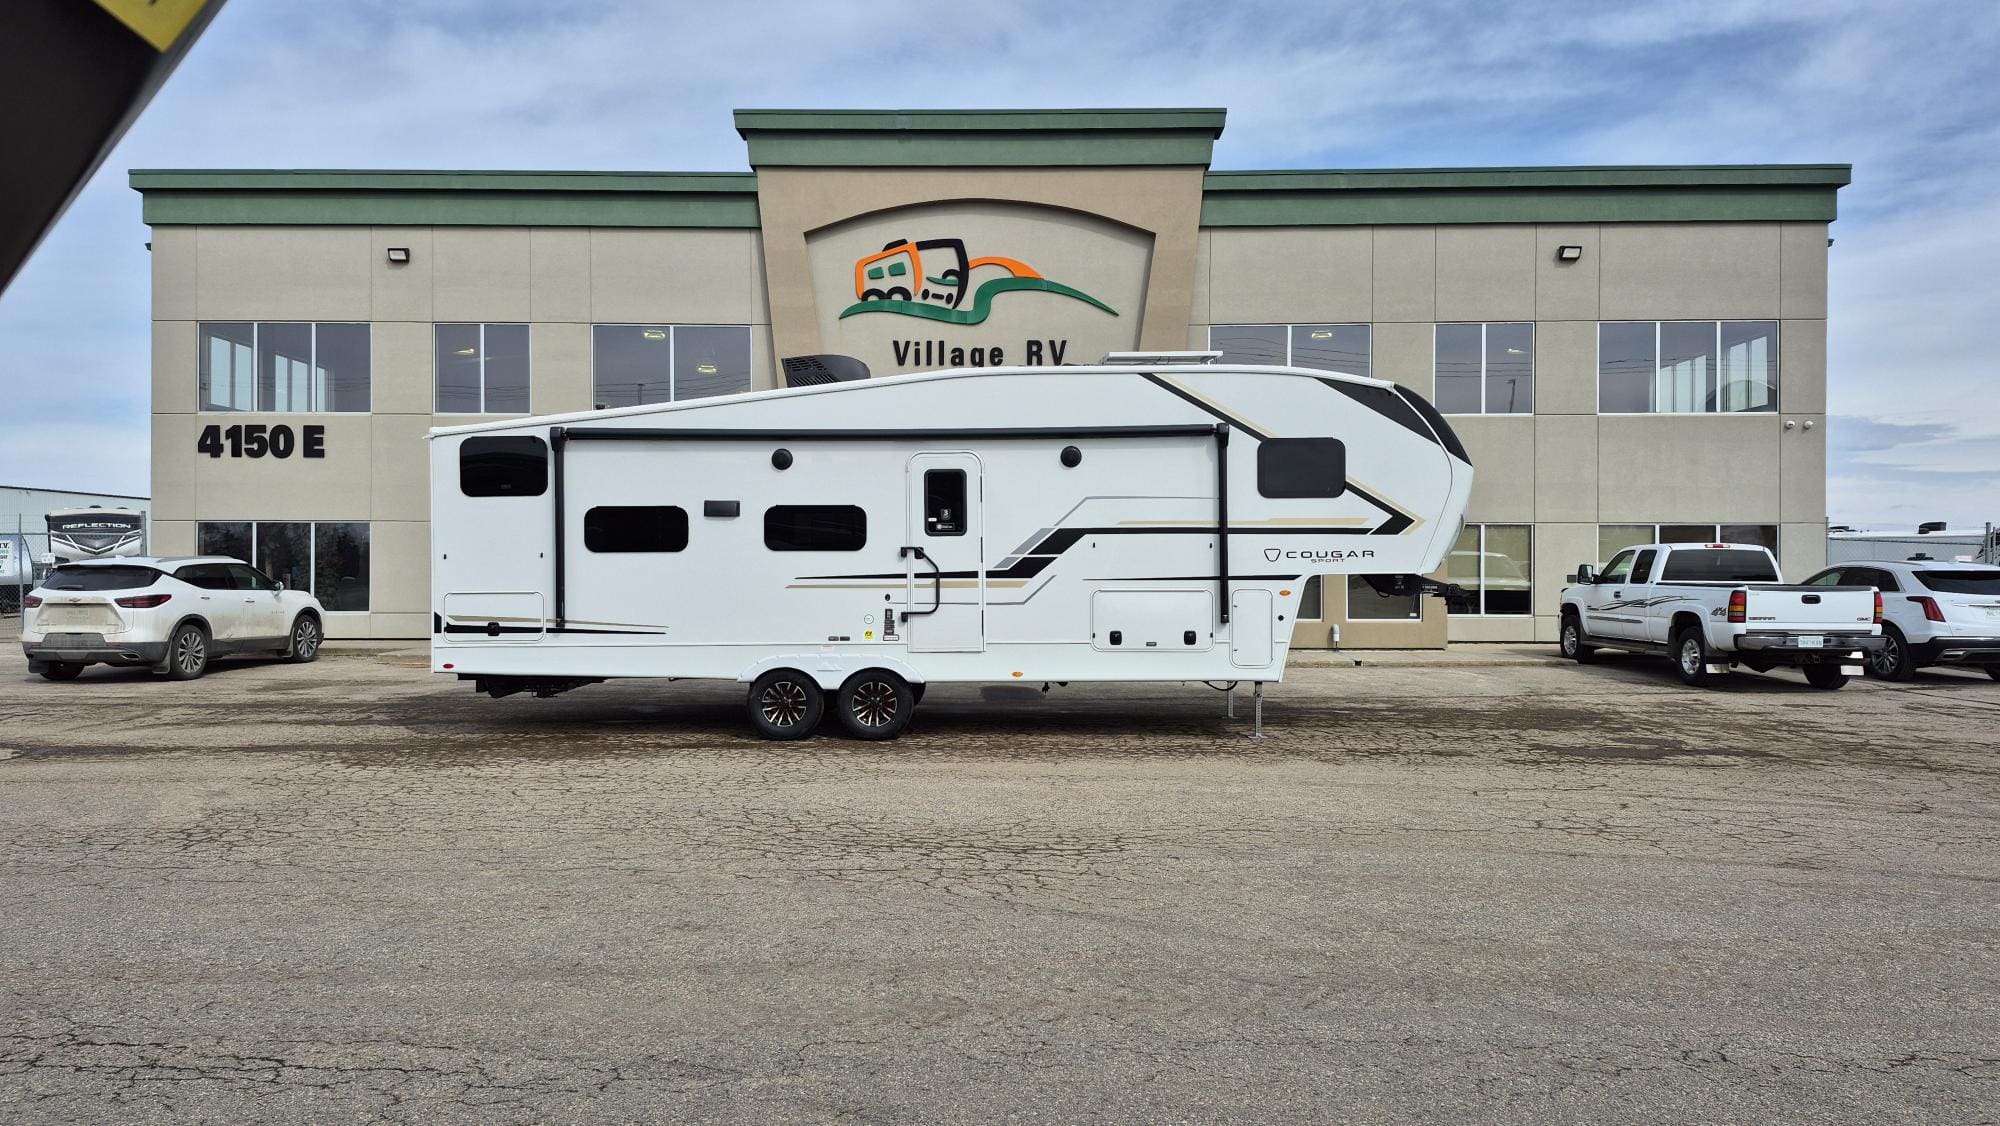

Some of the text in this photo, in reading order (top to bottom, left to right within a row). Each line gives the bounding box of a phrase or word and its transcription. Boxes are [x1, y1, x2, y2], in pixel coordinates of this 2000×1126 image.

[892, 340, 1067, 367] Village RV
[198, 424, 325, 459] 4150 E
[62, 522, 131, 530] REFLECTION
[1286, 550, 1375, 559] COUGAR
